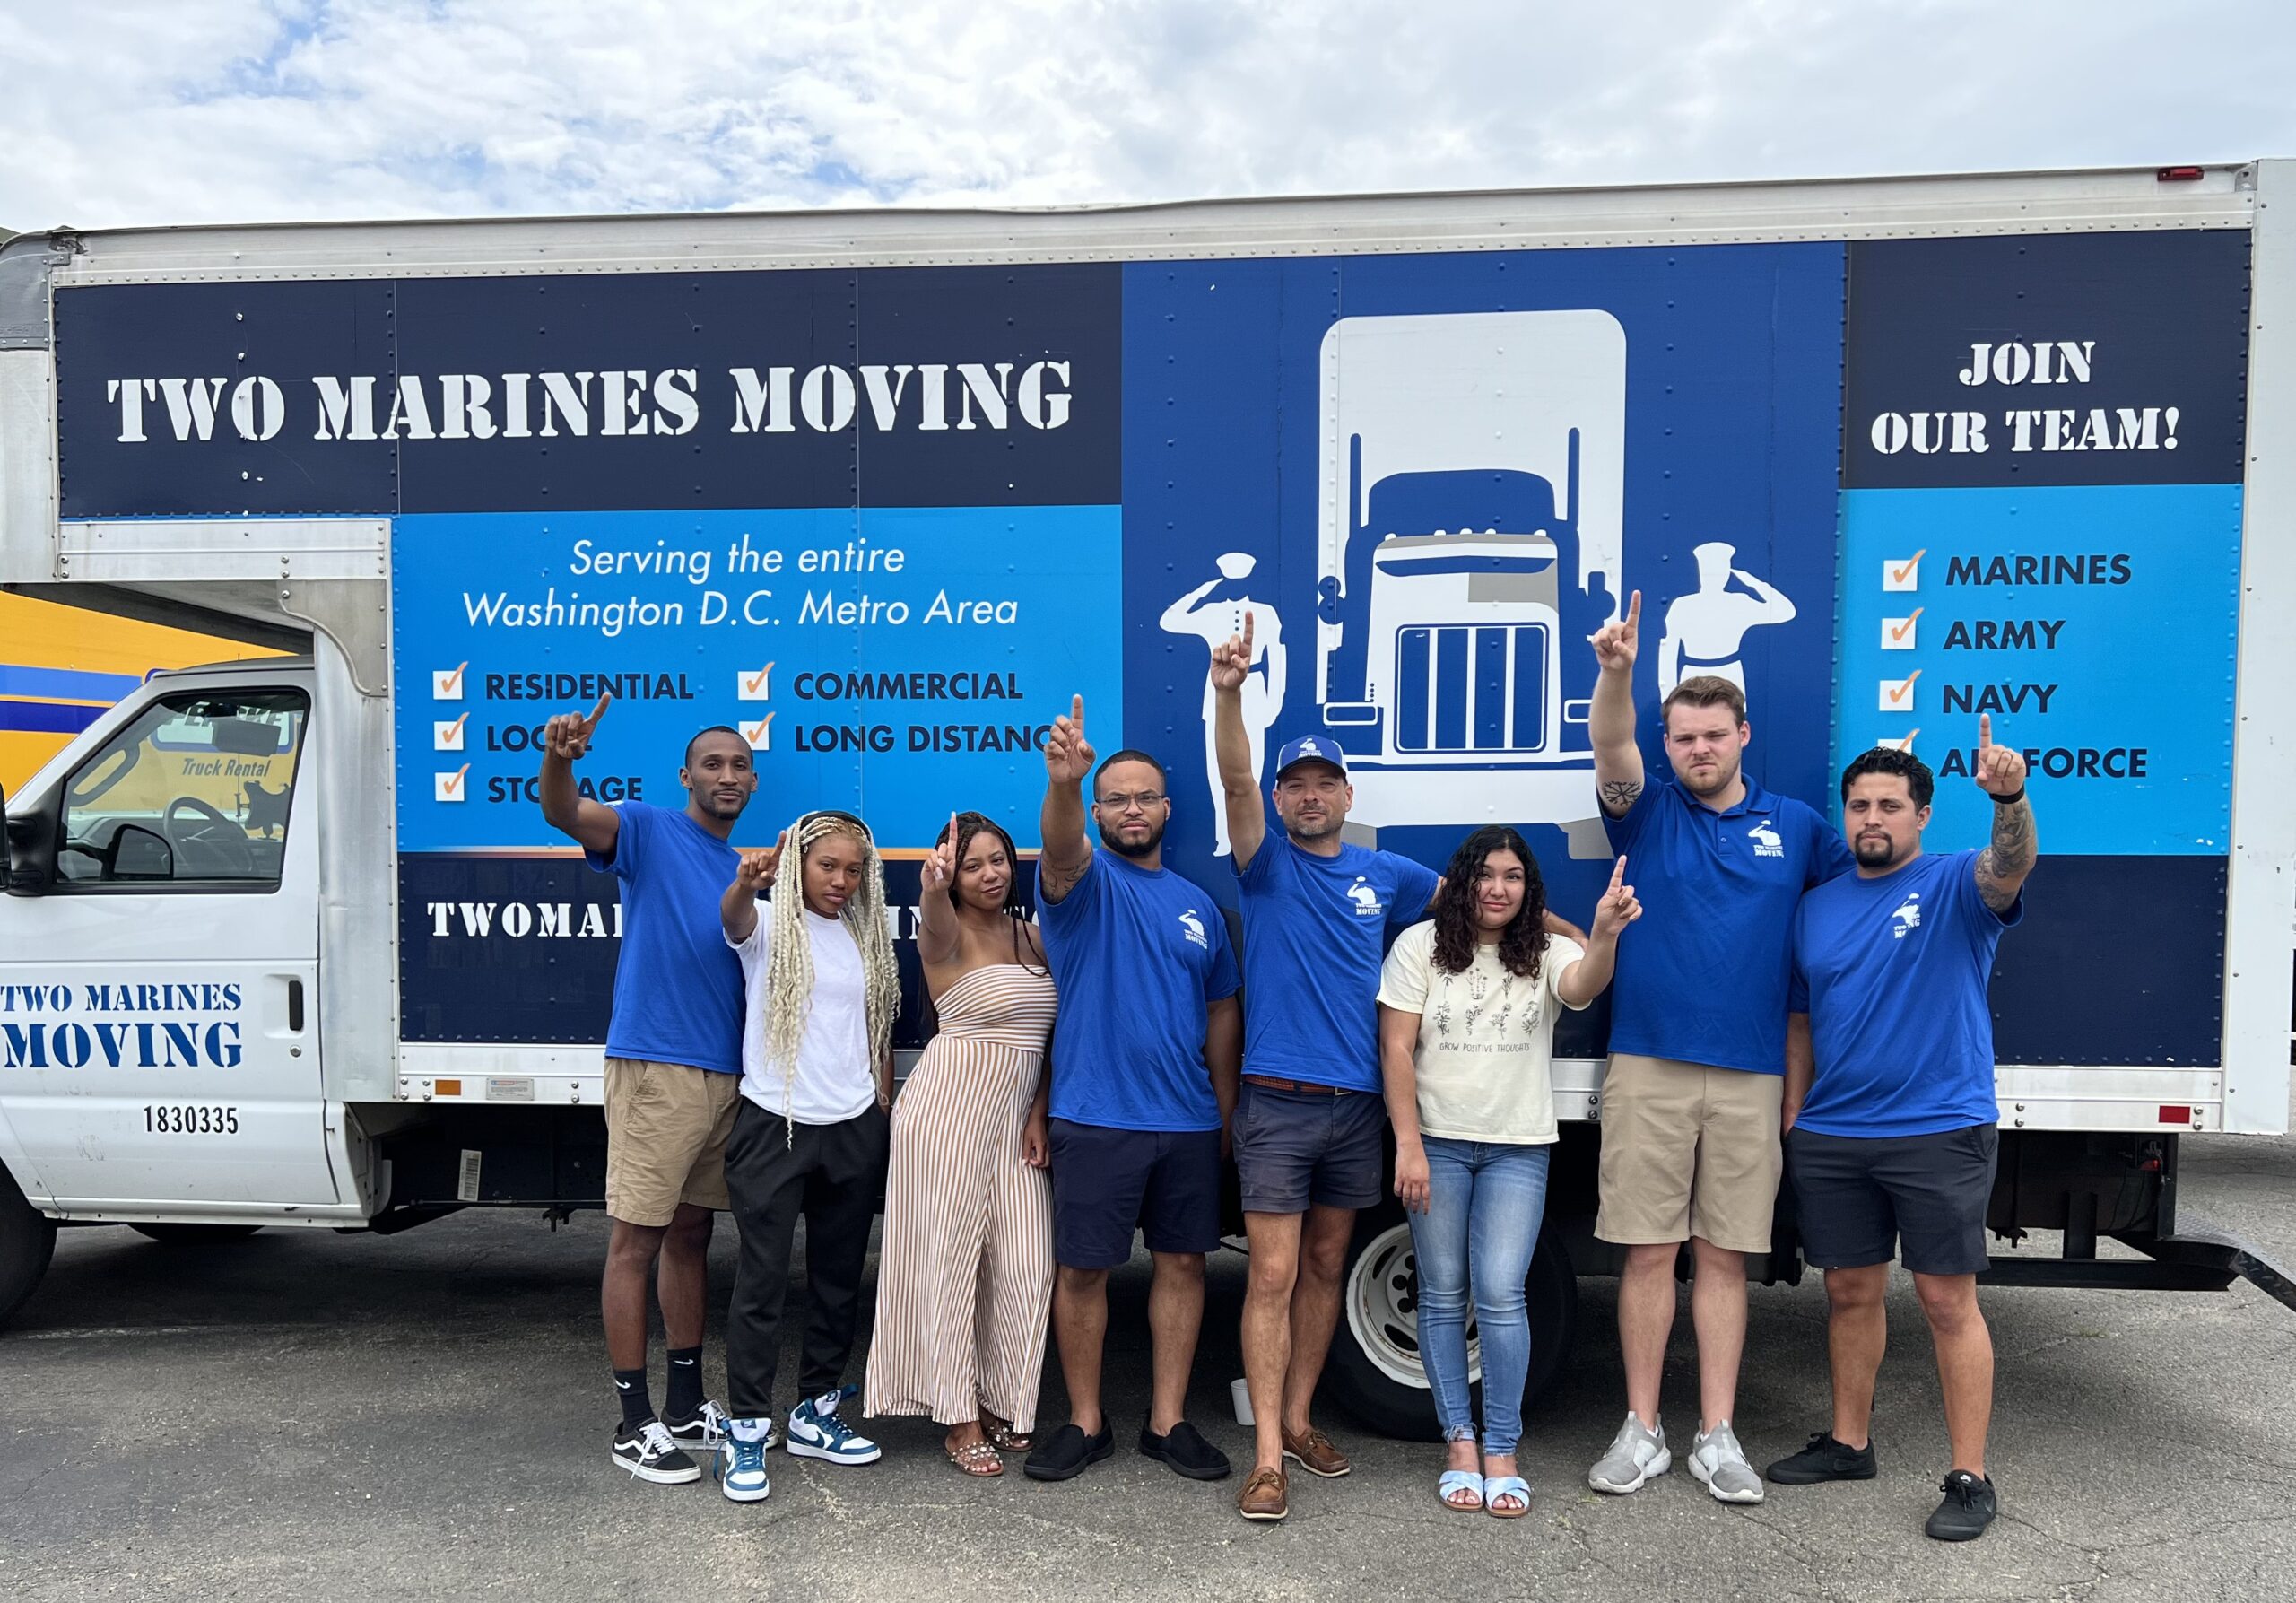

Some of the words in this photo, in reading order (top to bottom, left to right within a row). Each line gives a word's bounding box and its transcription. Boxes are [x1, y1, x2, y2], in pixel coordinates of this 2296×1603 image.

[1959, 341, 2096, 387] JOIN
[107, 376, 285, 443] TWO
[313, 368, 700, 440] MARINES
[728, 360, 1074, 434] MOVING
[1871, 412, 1990, 456] OUR
[2005, 406, 2180, 452] TEAM!
[570, 539, 712, 585] Serving
[727, 533, 783, 574] the
[797, 537, 905, 573] entire
[1945, 553, 2132, 586] MARINES
[463, 587, 683, 637] Washington
[700, 589, 780, 626] D.C.
[798, 588, 909, 625] Metro
[922, 588, 1019, 625] Area
[1942, 620, 2066, 650] ARMY
[486, 673, 694, 701] RESIDENTIAL
[794, 672, 1023, 701] COMMERCIAL
[1942, 684, 2058, 714] NAVY
[795, 725, 895, 753] LONG
[908, 724, 1053, 753] DISTANC
[182, 758, 222, 776] Truck
[224, 760, 272, 778] Rental
[2023, 746, 2148, 778] FORCE
[488, 776, 643, 803] STOAGE
[0, 985, 73, 1012] TWO
[85, 983, 242, 1012] MARINES
[1, 1022, 242, 1068] MOVING
[1439, 1041, 1460, 1051] GROW
[1463, 1043, 1493, 1053] POSITIVE
[1497, 1042, 1530, 1053] THOUGHTS
[144, 1105, 239, 1134] 1830335
